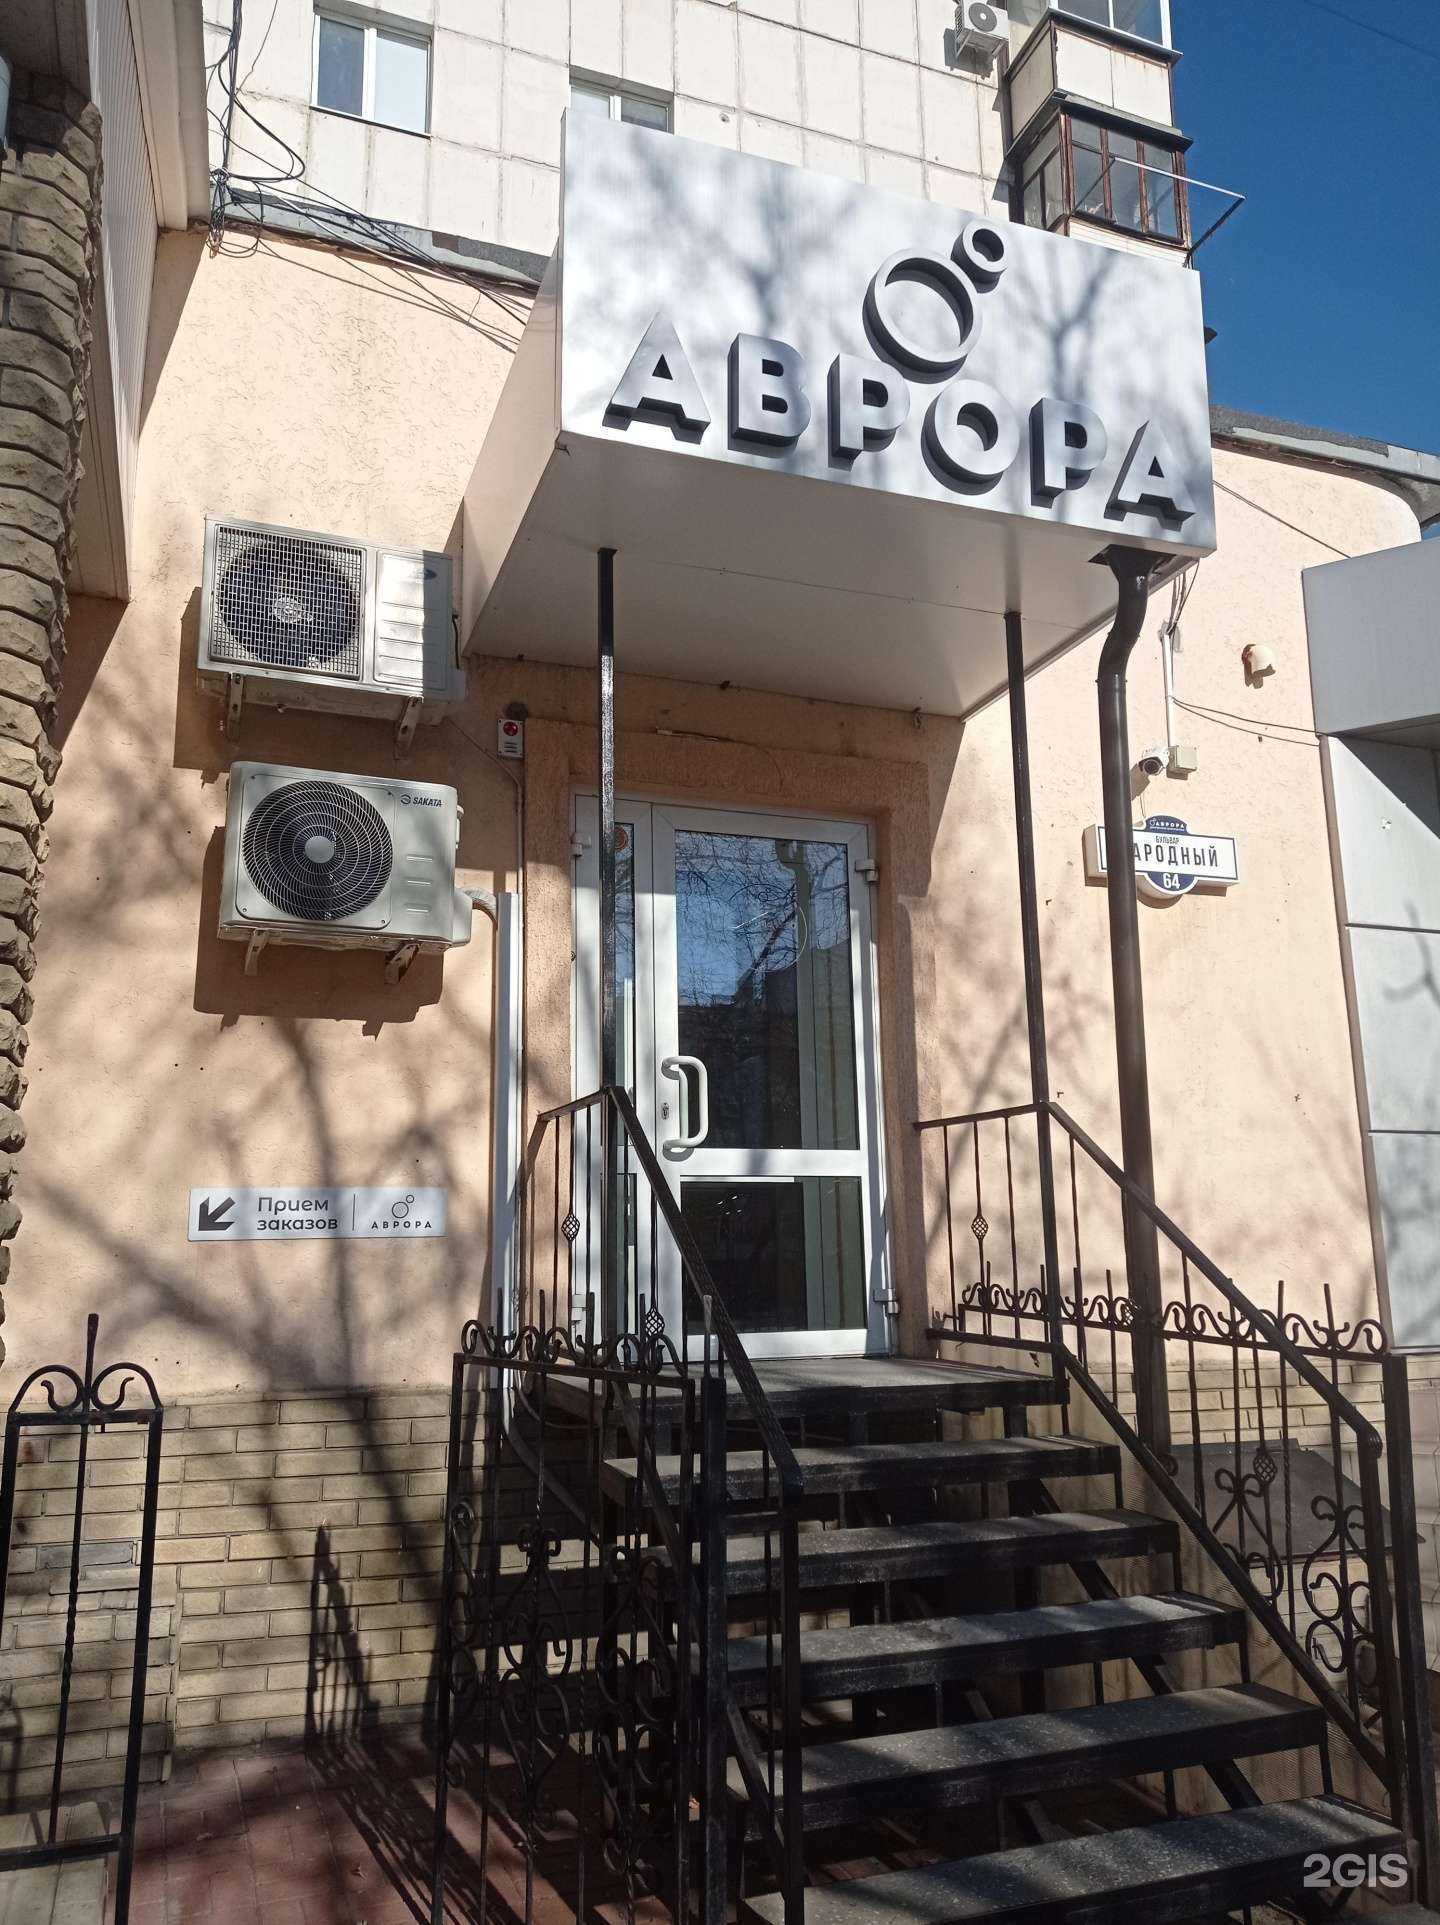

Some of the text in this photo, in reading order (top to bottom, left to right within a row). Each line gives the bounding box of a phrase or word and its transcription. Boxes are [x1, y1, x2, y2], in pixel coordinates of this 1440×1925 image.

[603, 312, 1196, 530] АВРОРА
[413, 797, 442, 807] SAKATA
[1133, 842, 1218, 867] АРОДНЫЙ
[1162, 873, 1181, 890] 64
[257, 1196, 329, 1215] Прием
[257, 1217, 338, 1231] заказов
[371, 1220, 433, 1229] АВРОРА
